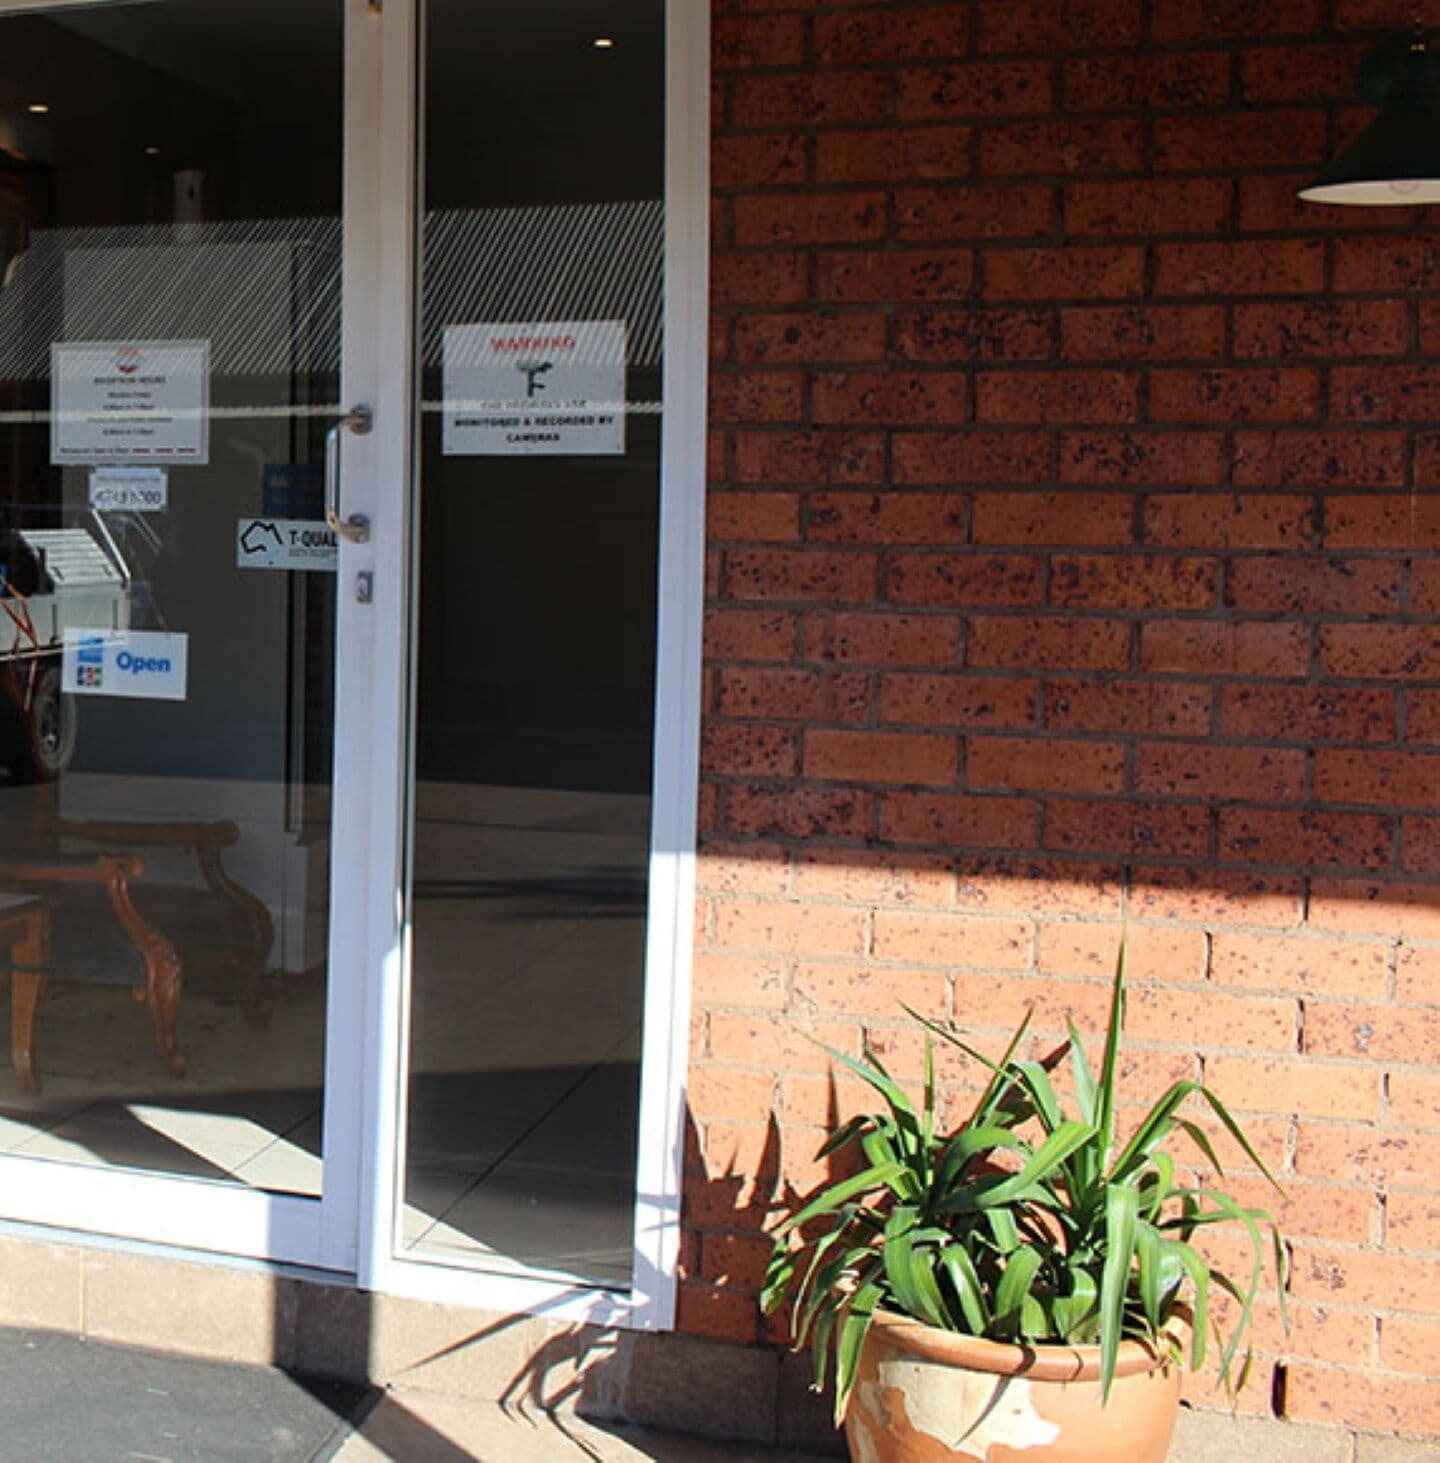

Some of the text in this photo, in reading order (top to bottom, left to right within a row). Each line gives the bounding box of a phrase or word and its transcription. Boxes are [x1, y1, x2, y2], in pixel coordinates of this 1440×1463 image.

[490, 334, 576, 351] WARNING
[455, 416, 520, 426] MONITORED
[534, 416, 595, 426] RECORDED
[506, 432, 560, 443] CAMERAS
[116, 651, 172, 675] Open
